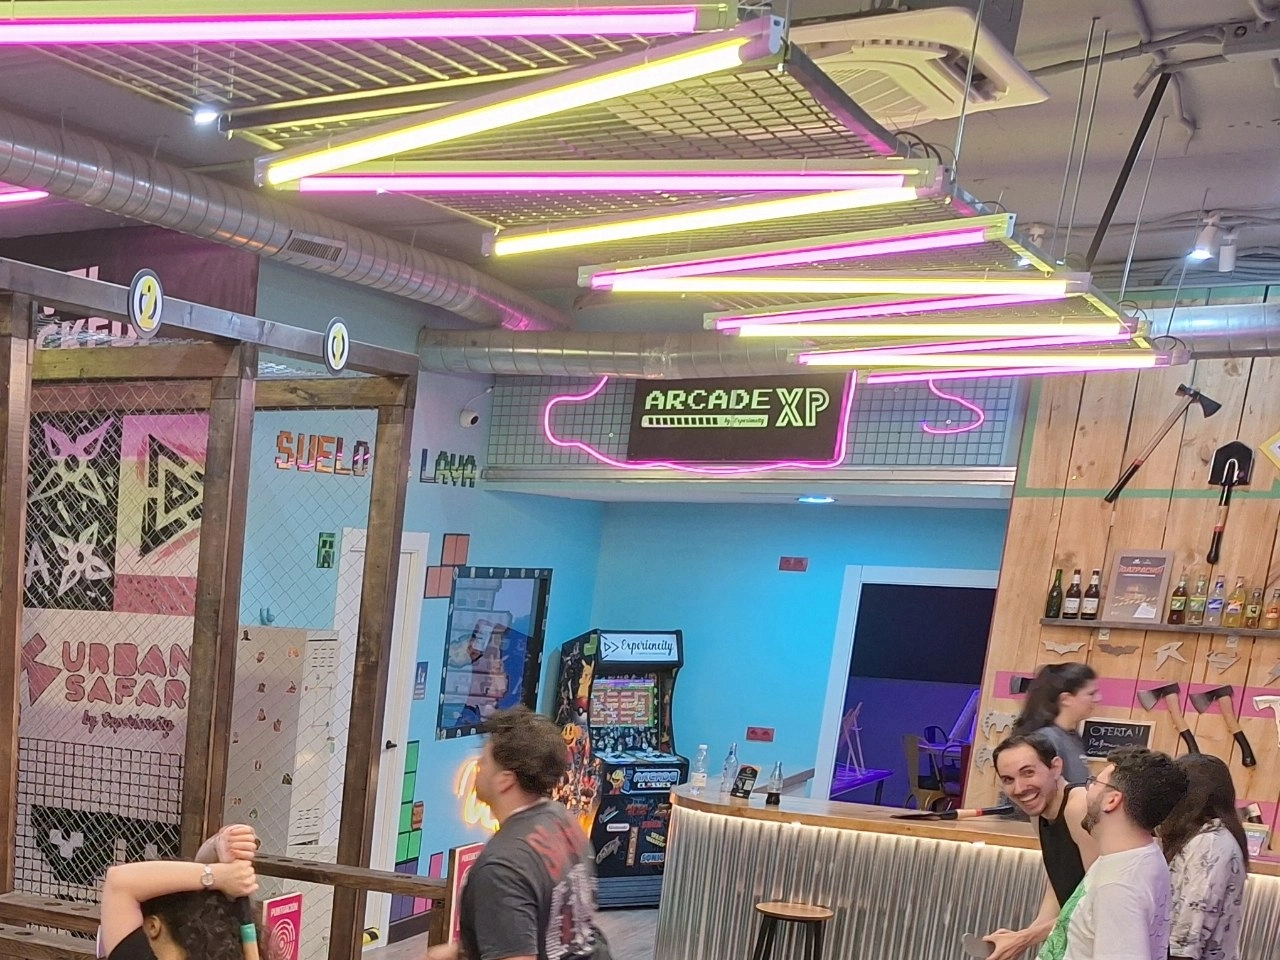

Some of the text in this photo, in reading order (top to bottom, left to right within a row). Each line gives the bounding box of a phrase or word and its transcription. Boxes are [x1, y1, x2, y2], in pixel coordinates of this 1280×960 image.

[139, 275, 157, 329] 2
[333, 326, 344, 368] 1
[644, 388, 830, 427] ARCADE XP
[275, 430, 370, 477] SUELO
[62, 640, 192, 678] URBAN
[65, 674, 187, 709] SAFAR
